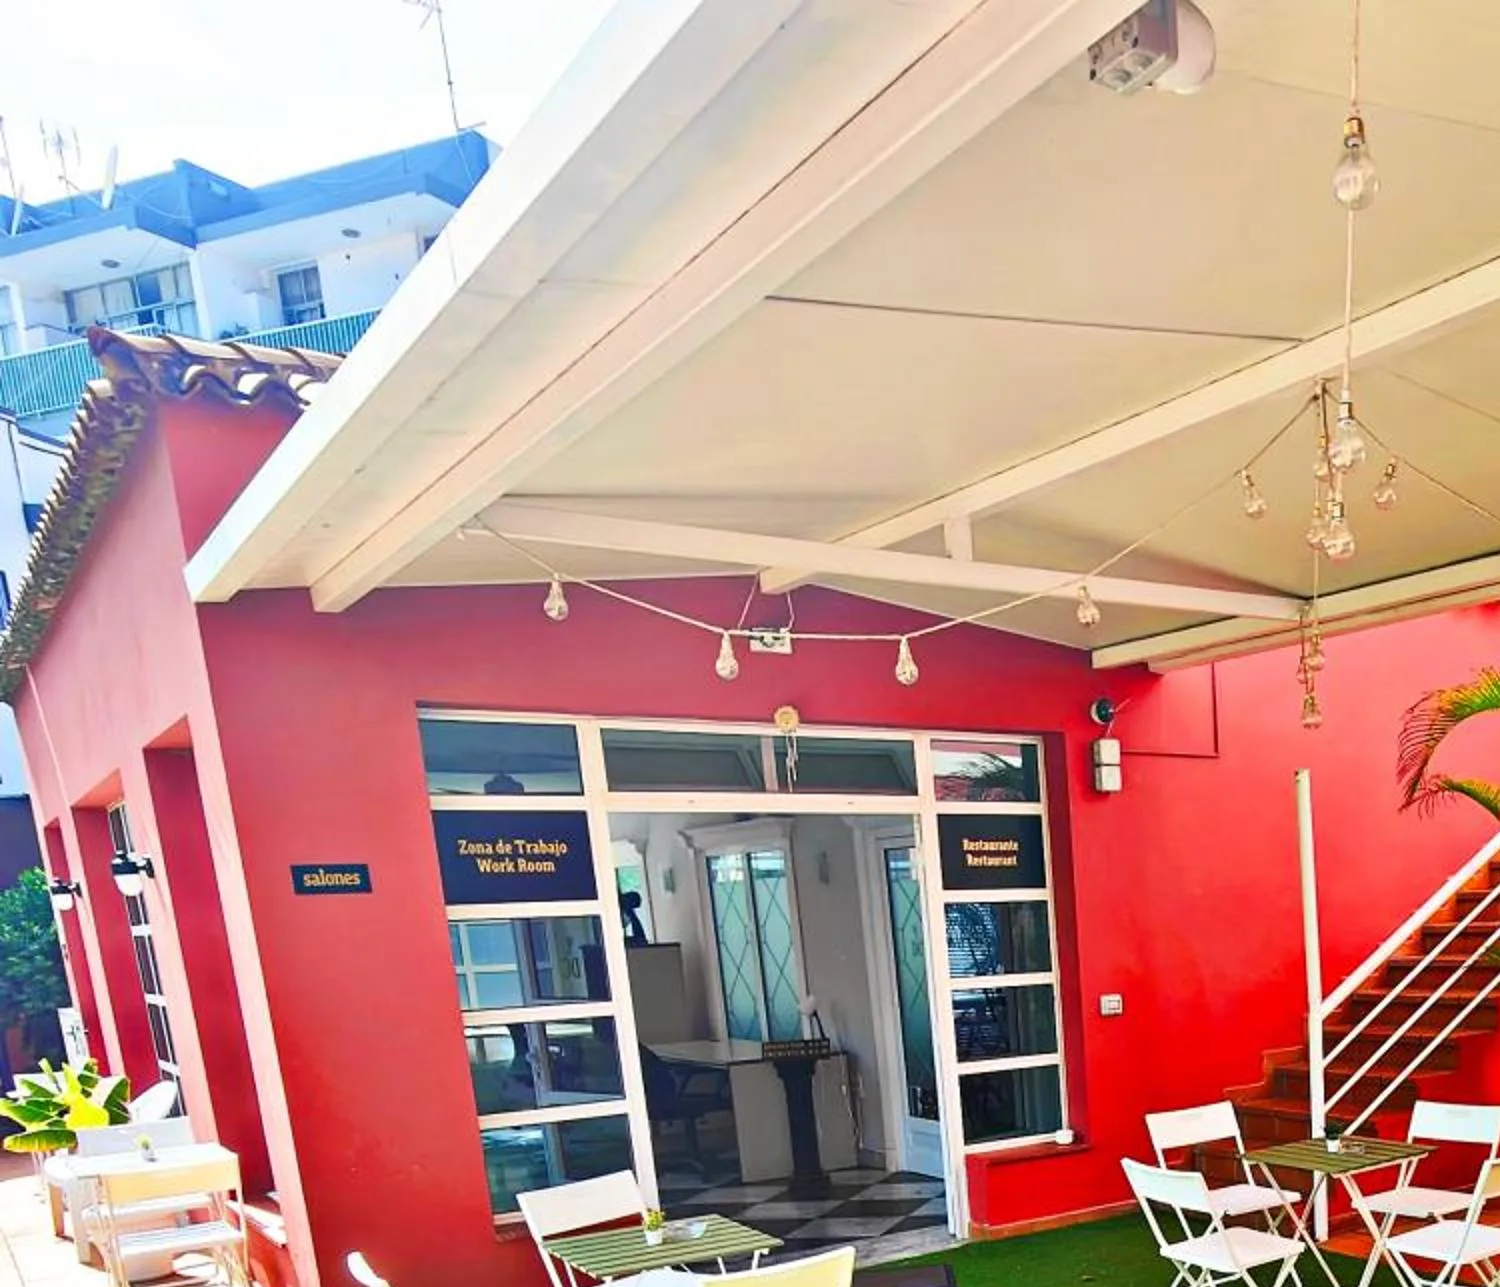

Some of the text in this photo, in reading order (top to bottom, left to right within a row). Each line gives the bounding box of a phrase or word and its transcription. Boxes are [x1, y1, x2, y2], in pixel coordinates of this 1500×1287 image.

[457, 839, 568, 857] Zona de Trabajo
[476, 858, 556, 873] Work Room
[303, 868, 361, 887] salones
